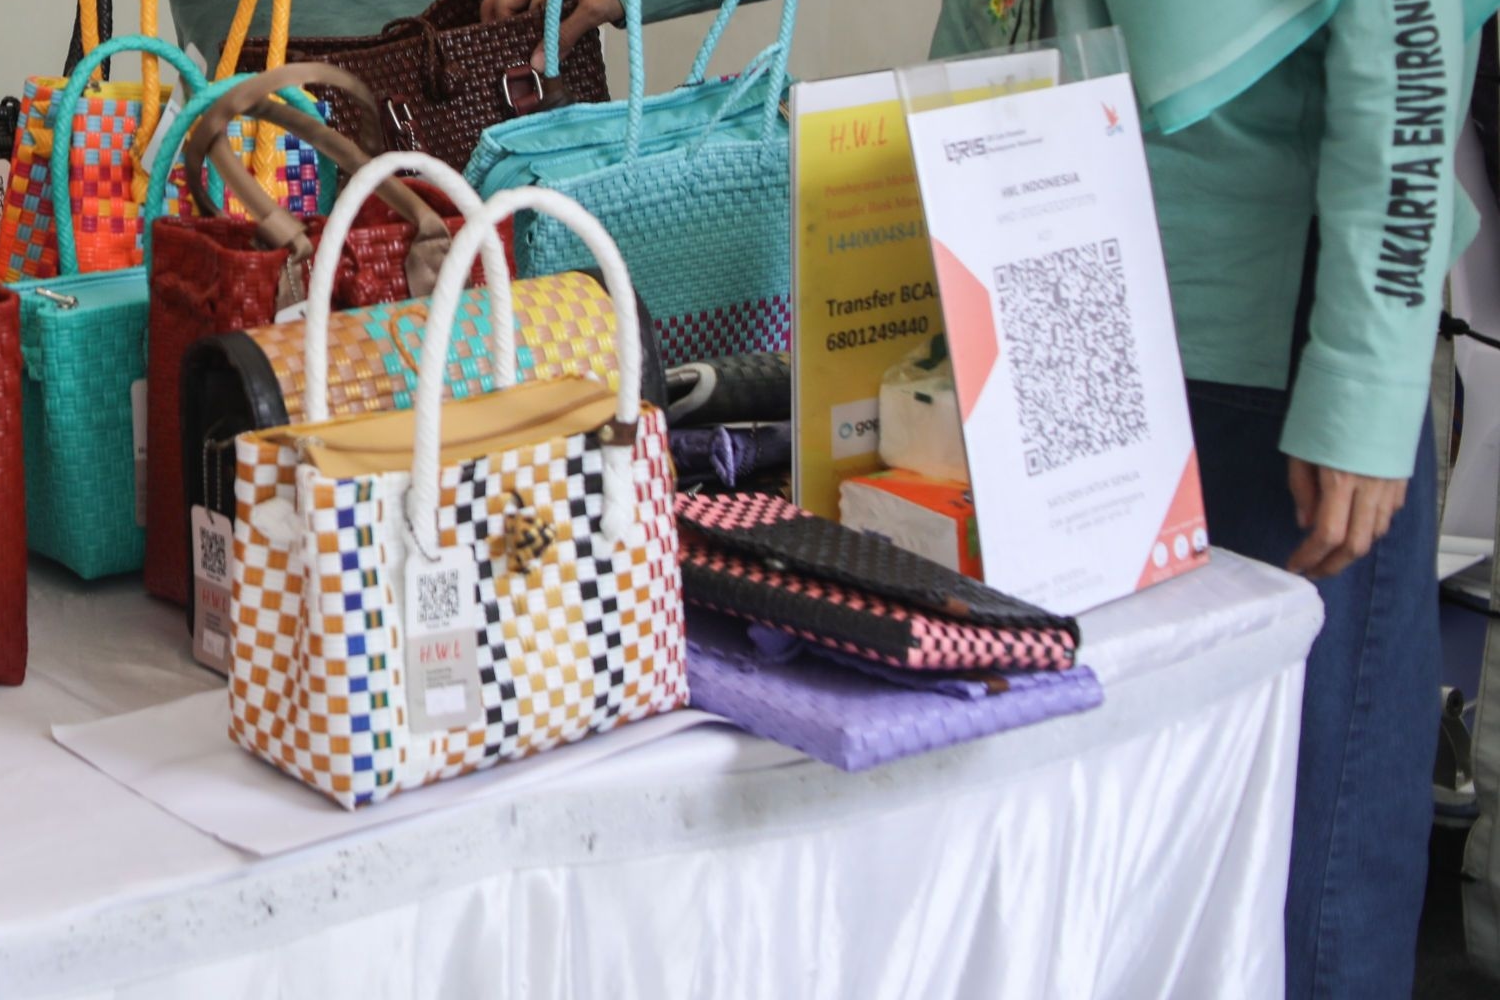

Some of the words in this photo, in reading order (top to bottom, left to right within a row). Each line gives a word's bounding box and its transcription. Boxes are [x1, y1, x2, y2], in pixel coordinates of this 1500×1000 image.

[1022, 172, 1081, 194] INDONESIA
[1374, 157, 1444, 308] JAKARTA
[826, 291, 897, 317] Transfer
[826, 316, 929, 351] 6801249440
